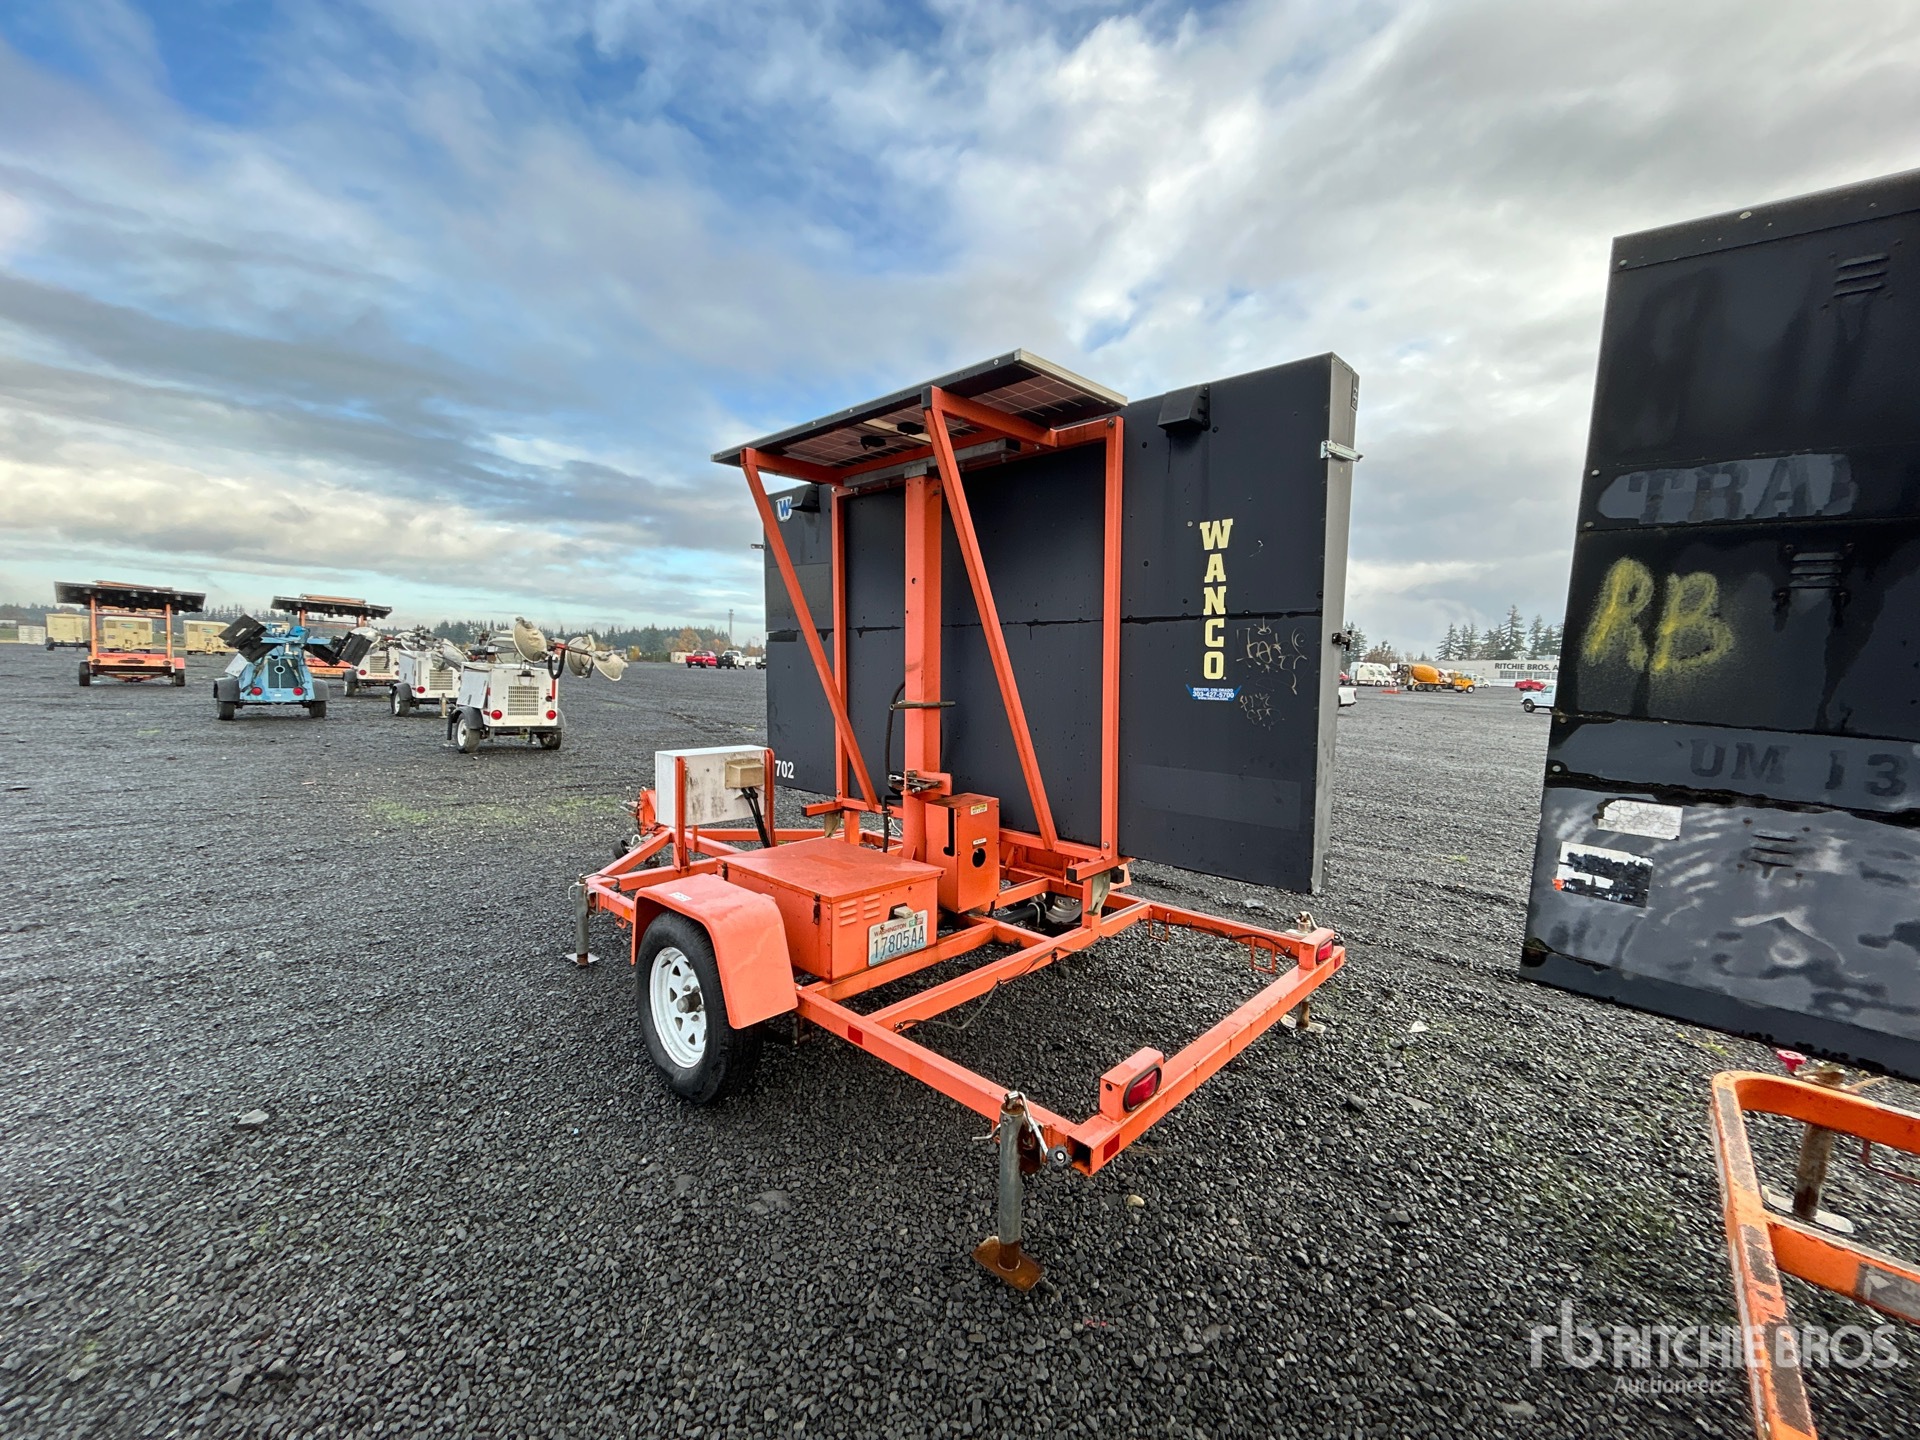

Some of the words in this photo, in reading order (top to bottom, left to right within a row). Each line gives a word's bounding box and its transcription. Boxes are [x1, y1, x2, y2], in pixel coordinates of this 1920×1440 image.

[1199, 518, 1234, 680] WANCO
[1582, 556, 1736, 676] RB
[1494, 662, 1525, 670] RITCHIE
[1527, 663, 1551, 671] BROS.
[775, 760, 795, 779] 702
[874, 923, 907, 937] WASHINGTON
[874, 925, 924, 958] 17805AA
